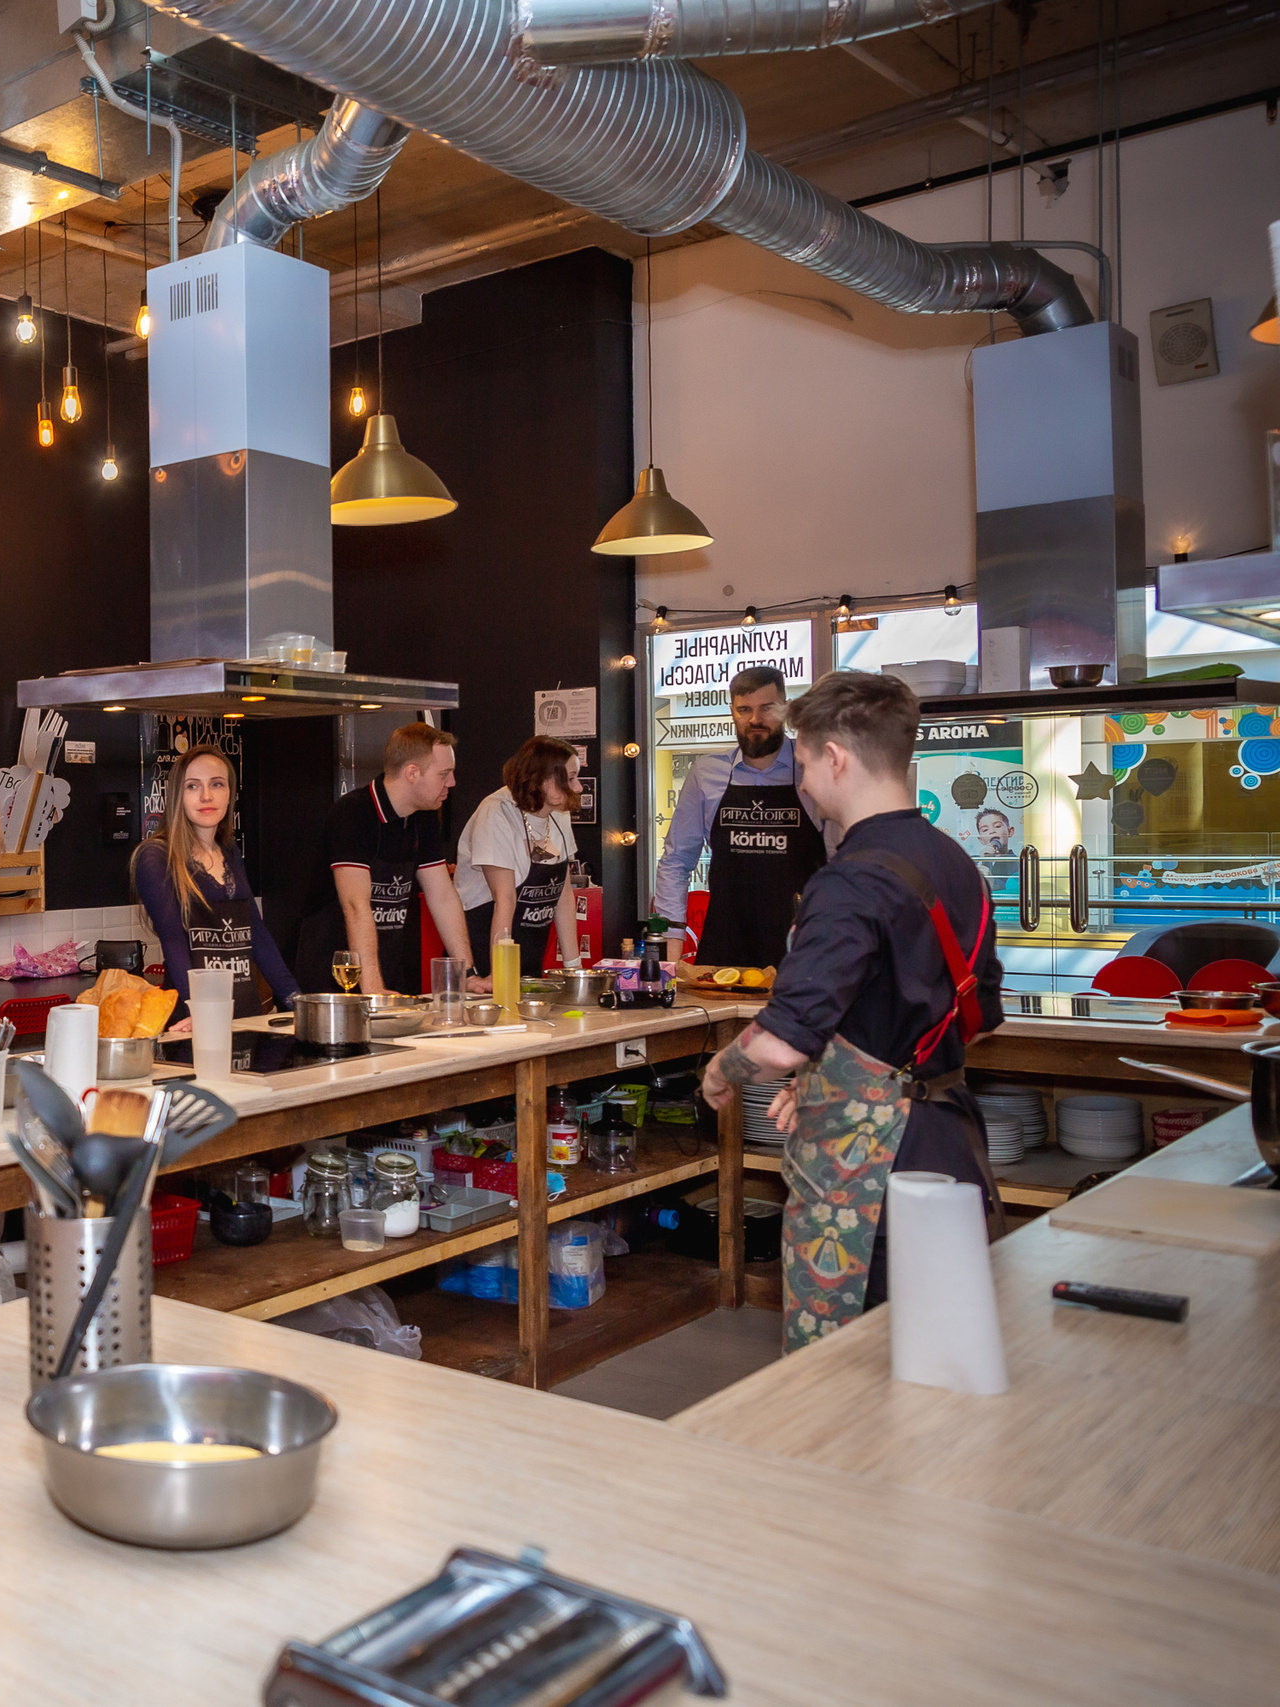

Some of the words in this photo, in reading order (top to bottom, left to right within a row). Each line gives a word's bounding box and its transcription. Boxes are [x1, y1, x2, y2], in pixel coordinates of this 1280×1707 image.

[928, 725, 990, 740] AROMA
[722, 810, 749, 821] ИГРА
[750, 810, 797, 821] СТОЛОВ
[730, 831, 788, 850] körting
[372, 907, 408, 924] örting
[191, 931, 220, 943] ИГРА
[204, 956, 250, 977] körting
